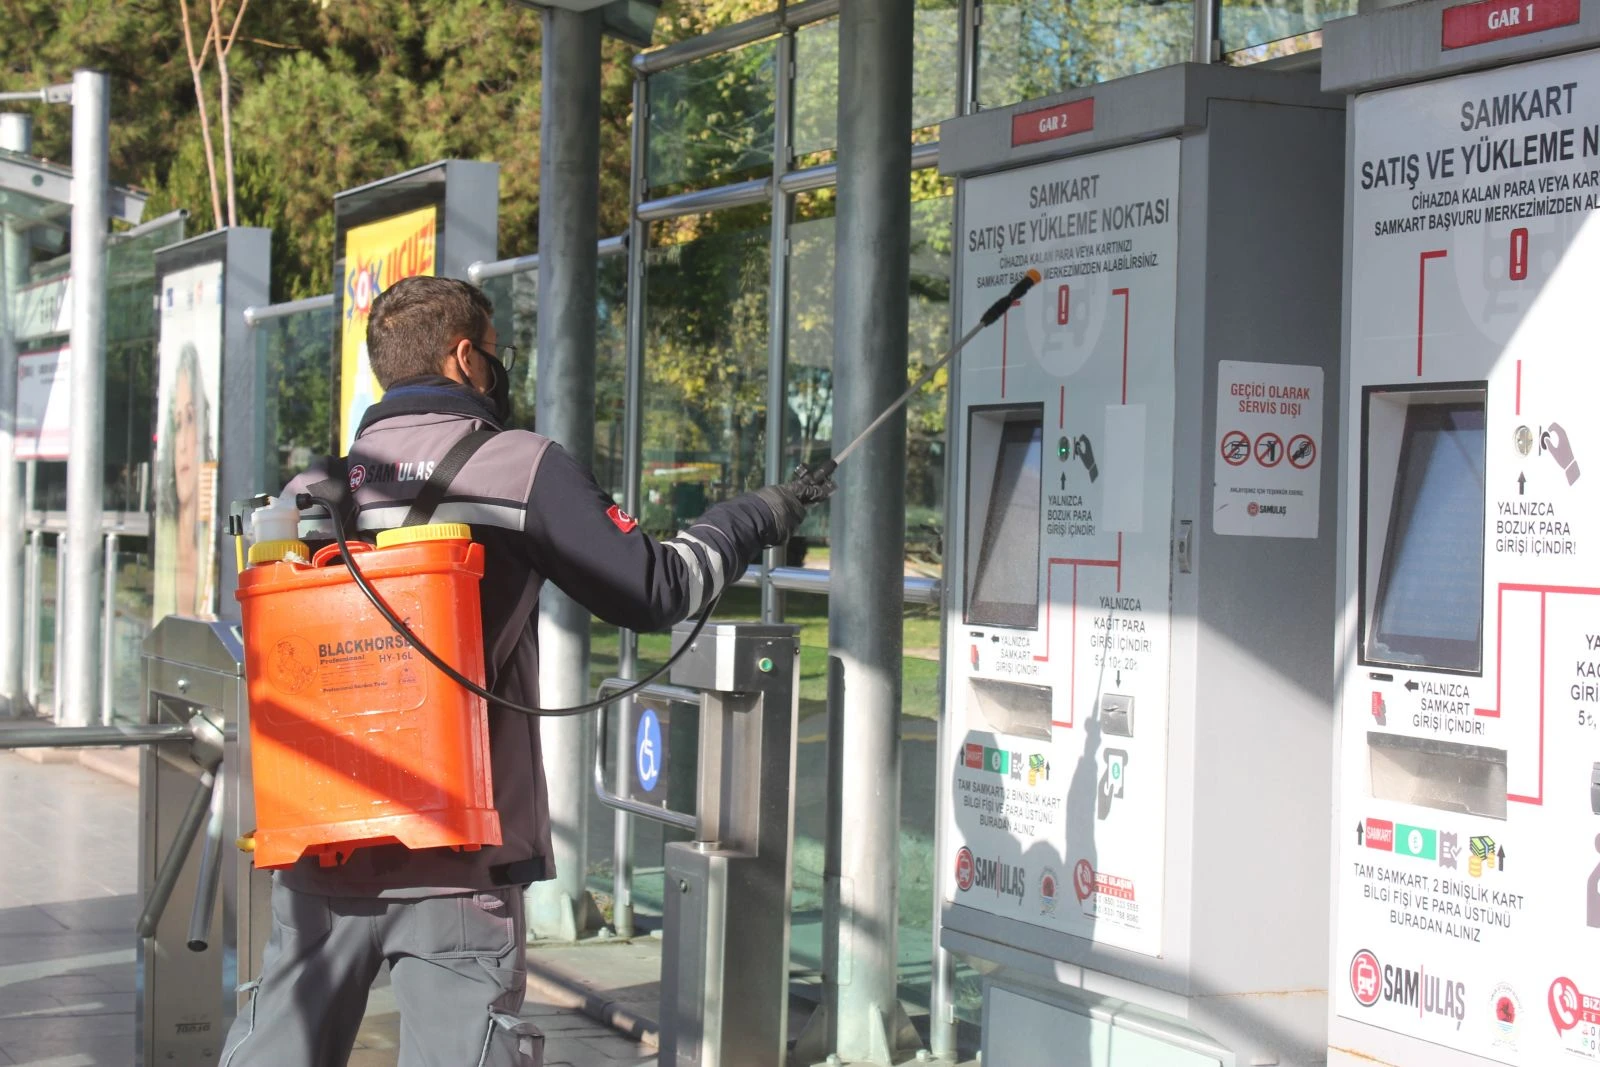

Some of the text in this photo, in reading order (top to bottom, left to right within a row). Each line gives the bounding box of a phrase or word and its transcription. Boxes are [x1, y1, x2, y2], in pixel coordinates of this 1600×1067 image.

[1488, 4, 1534, 30] GAR 1
[1460, 82, 1578, 132] SAMKART
[1039, 114, 1068, 132] GAR 2
[1361, 153, 1420, 190] SATIŞ
[1426, 148, 1454, 180] VE
[1461, 128, 1574, 174] YÜKLEME
[1030, 174, 1100, 209] SAMKART
[1412, 190, 1460, 210] CİHAZDA
[1462, 184, 1500, 203] KALAN
[1504, 179, 1535, 198] PARA
[1538, 175, 1568, 194] VEYA
[968, 198, 1170, 254] SATIŞ VE YÜKLEME NOKTASI
[1375, 215, 1426, 236] SAMKART
[1428, 208, 1482, 232] BAŞVURU
[1484, 196, 1582, 223] MERKEZİMİZDEN
[1076, 246, 1094, 259] VEYA
[1096, 239, 1132, 256] KARTINIZI
[976, 273, 1009, 289] SAMKART
[1230, 382, 1310, 400] GEÇİCİ OLARAK
[1238, 400, 1301, 418] SERVİS DIŞI
[1048, 496, 1082, 506] YALNIZCA
[1498, 501, 1554, 516] YALNIZCA
[1047, 510, 1092, 522] BOZUK PARA
[1497, 520, 1570, 536] BOZUK PARA
[1496, 536, 1576, 558] GİRİŞİ İÇİNDİR!
[1100, 596, 1142, 612] YALNIZCA
[1094, 615, 1146, 633] KAĞIT PARA
[378, 652, 412, 664] HY-16L
[1420, 680, 1470, 698] YALNIZCA
[1420, 698, 1470, 716] SAMKART
[1412, 714, 1485, 736] GİRİŞİ İÇİNDİR!
[958, 778, 972, 792] TAM
[1042, 796, 1062, 810] KART
[994, 802, 1004, 814] VE
[1006, 804, 1024, 818] PARA
[980, 814, 1035, 836] BURADAN ALINIZ
[1354, 862, 1374, 878] TAM
[1433, 878, 1440, 892] 2
[1442, 878, 1489, 904] BİNİŞLİK
[1492, 894, 1524, 910] KART
[1364, 884, 1511, 929] BİLGİ FİŞİ VE PARA ÜSTÜNÜ
[1390, 909, 1481, 943] BURADAN ALINIZ
